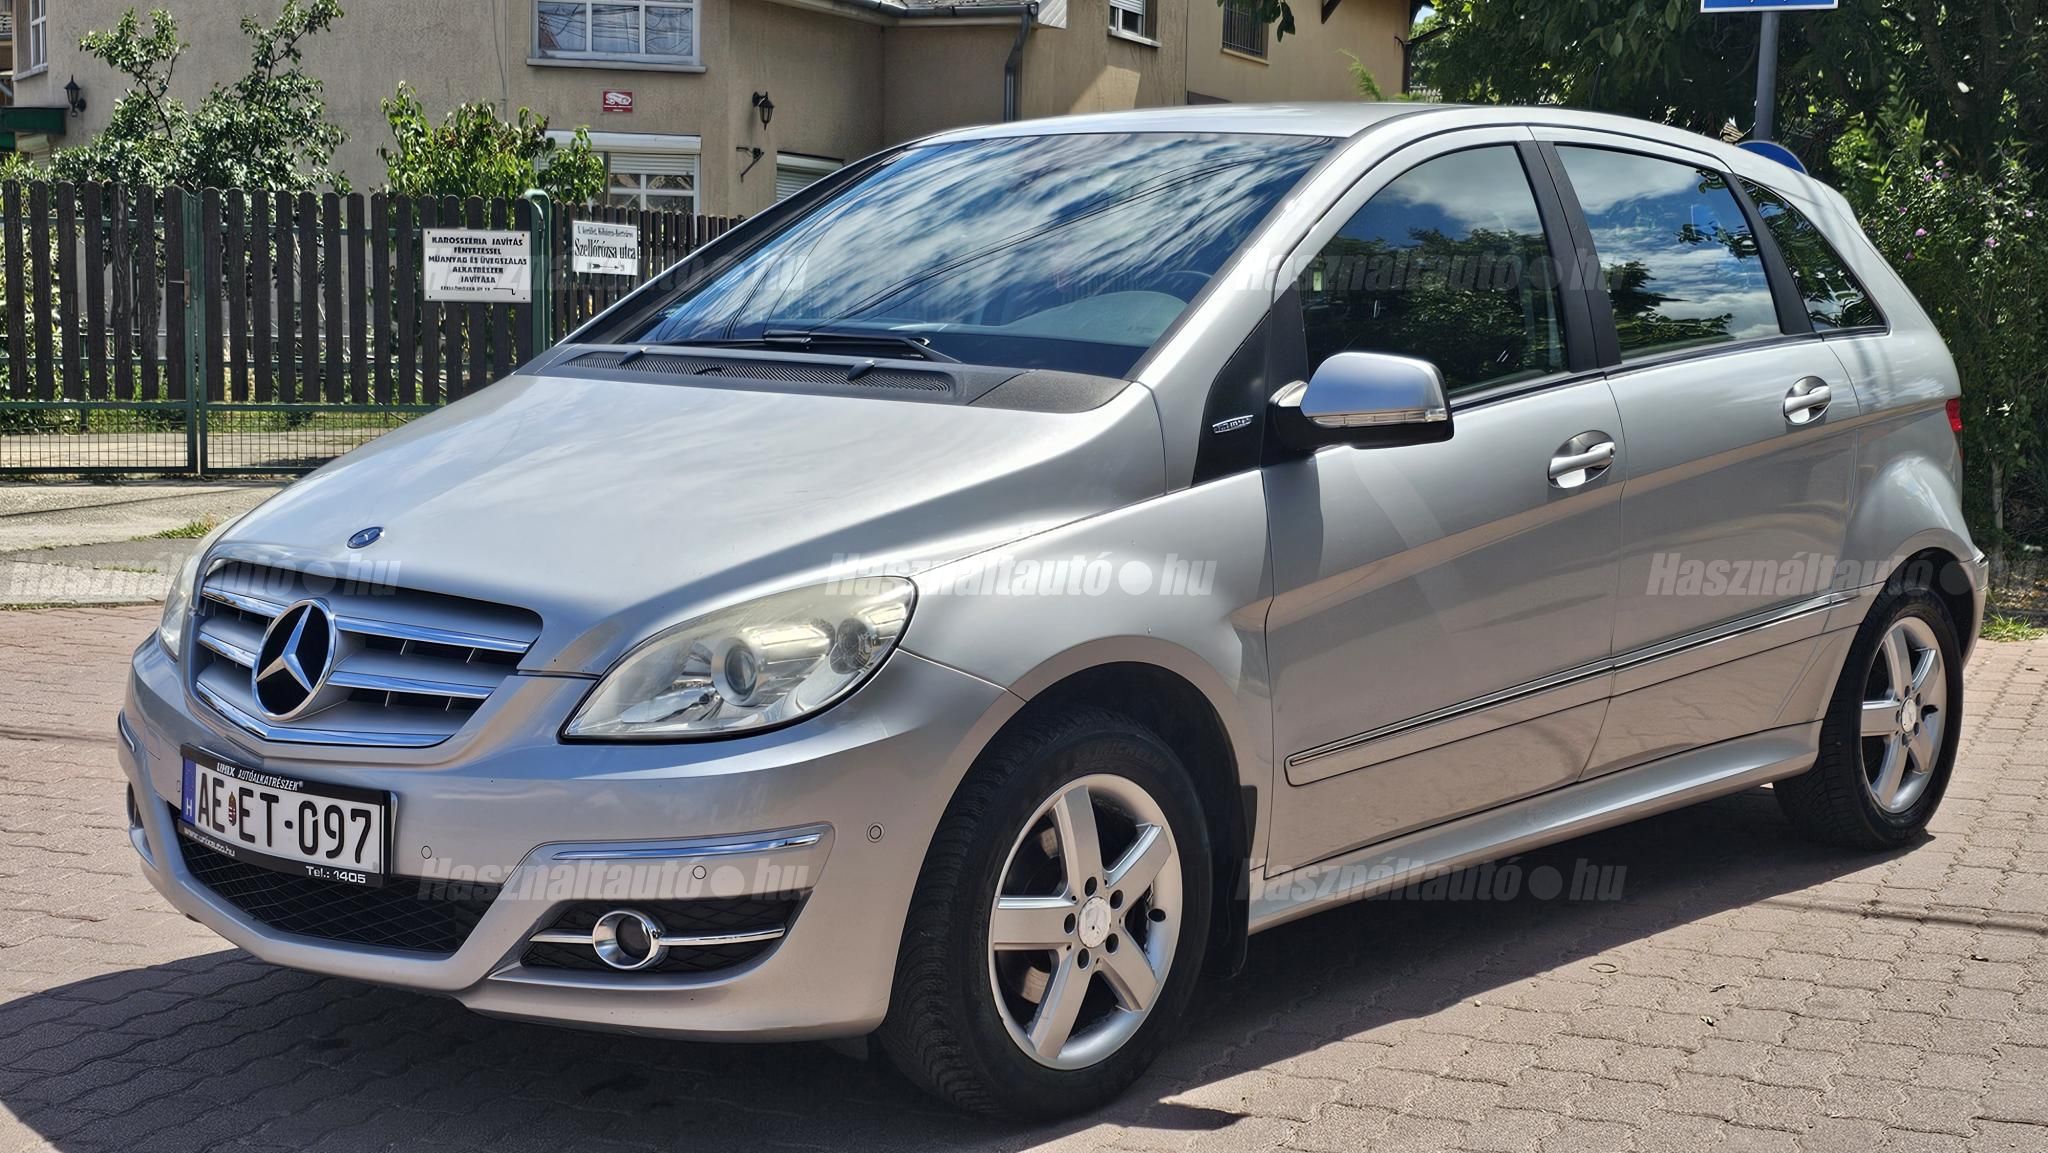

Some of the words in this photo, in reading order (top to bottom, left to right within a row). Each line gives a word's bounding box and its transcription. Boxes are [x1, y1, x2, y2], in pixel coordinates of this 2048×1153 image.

[619, 243, 636, 260] utca
[186, 800, 192, 817] H
[305, 865, 330, 879] Tel.:
[333, 870, 366, 884] 1405
